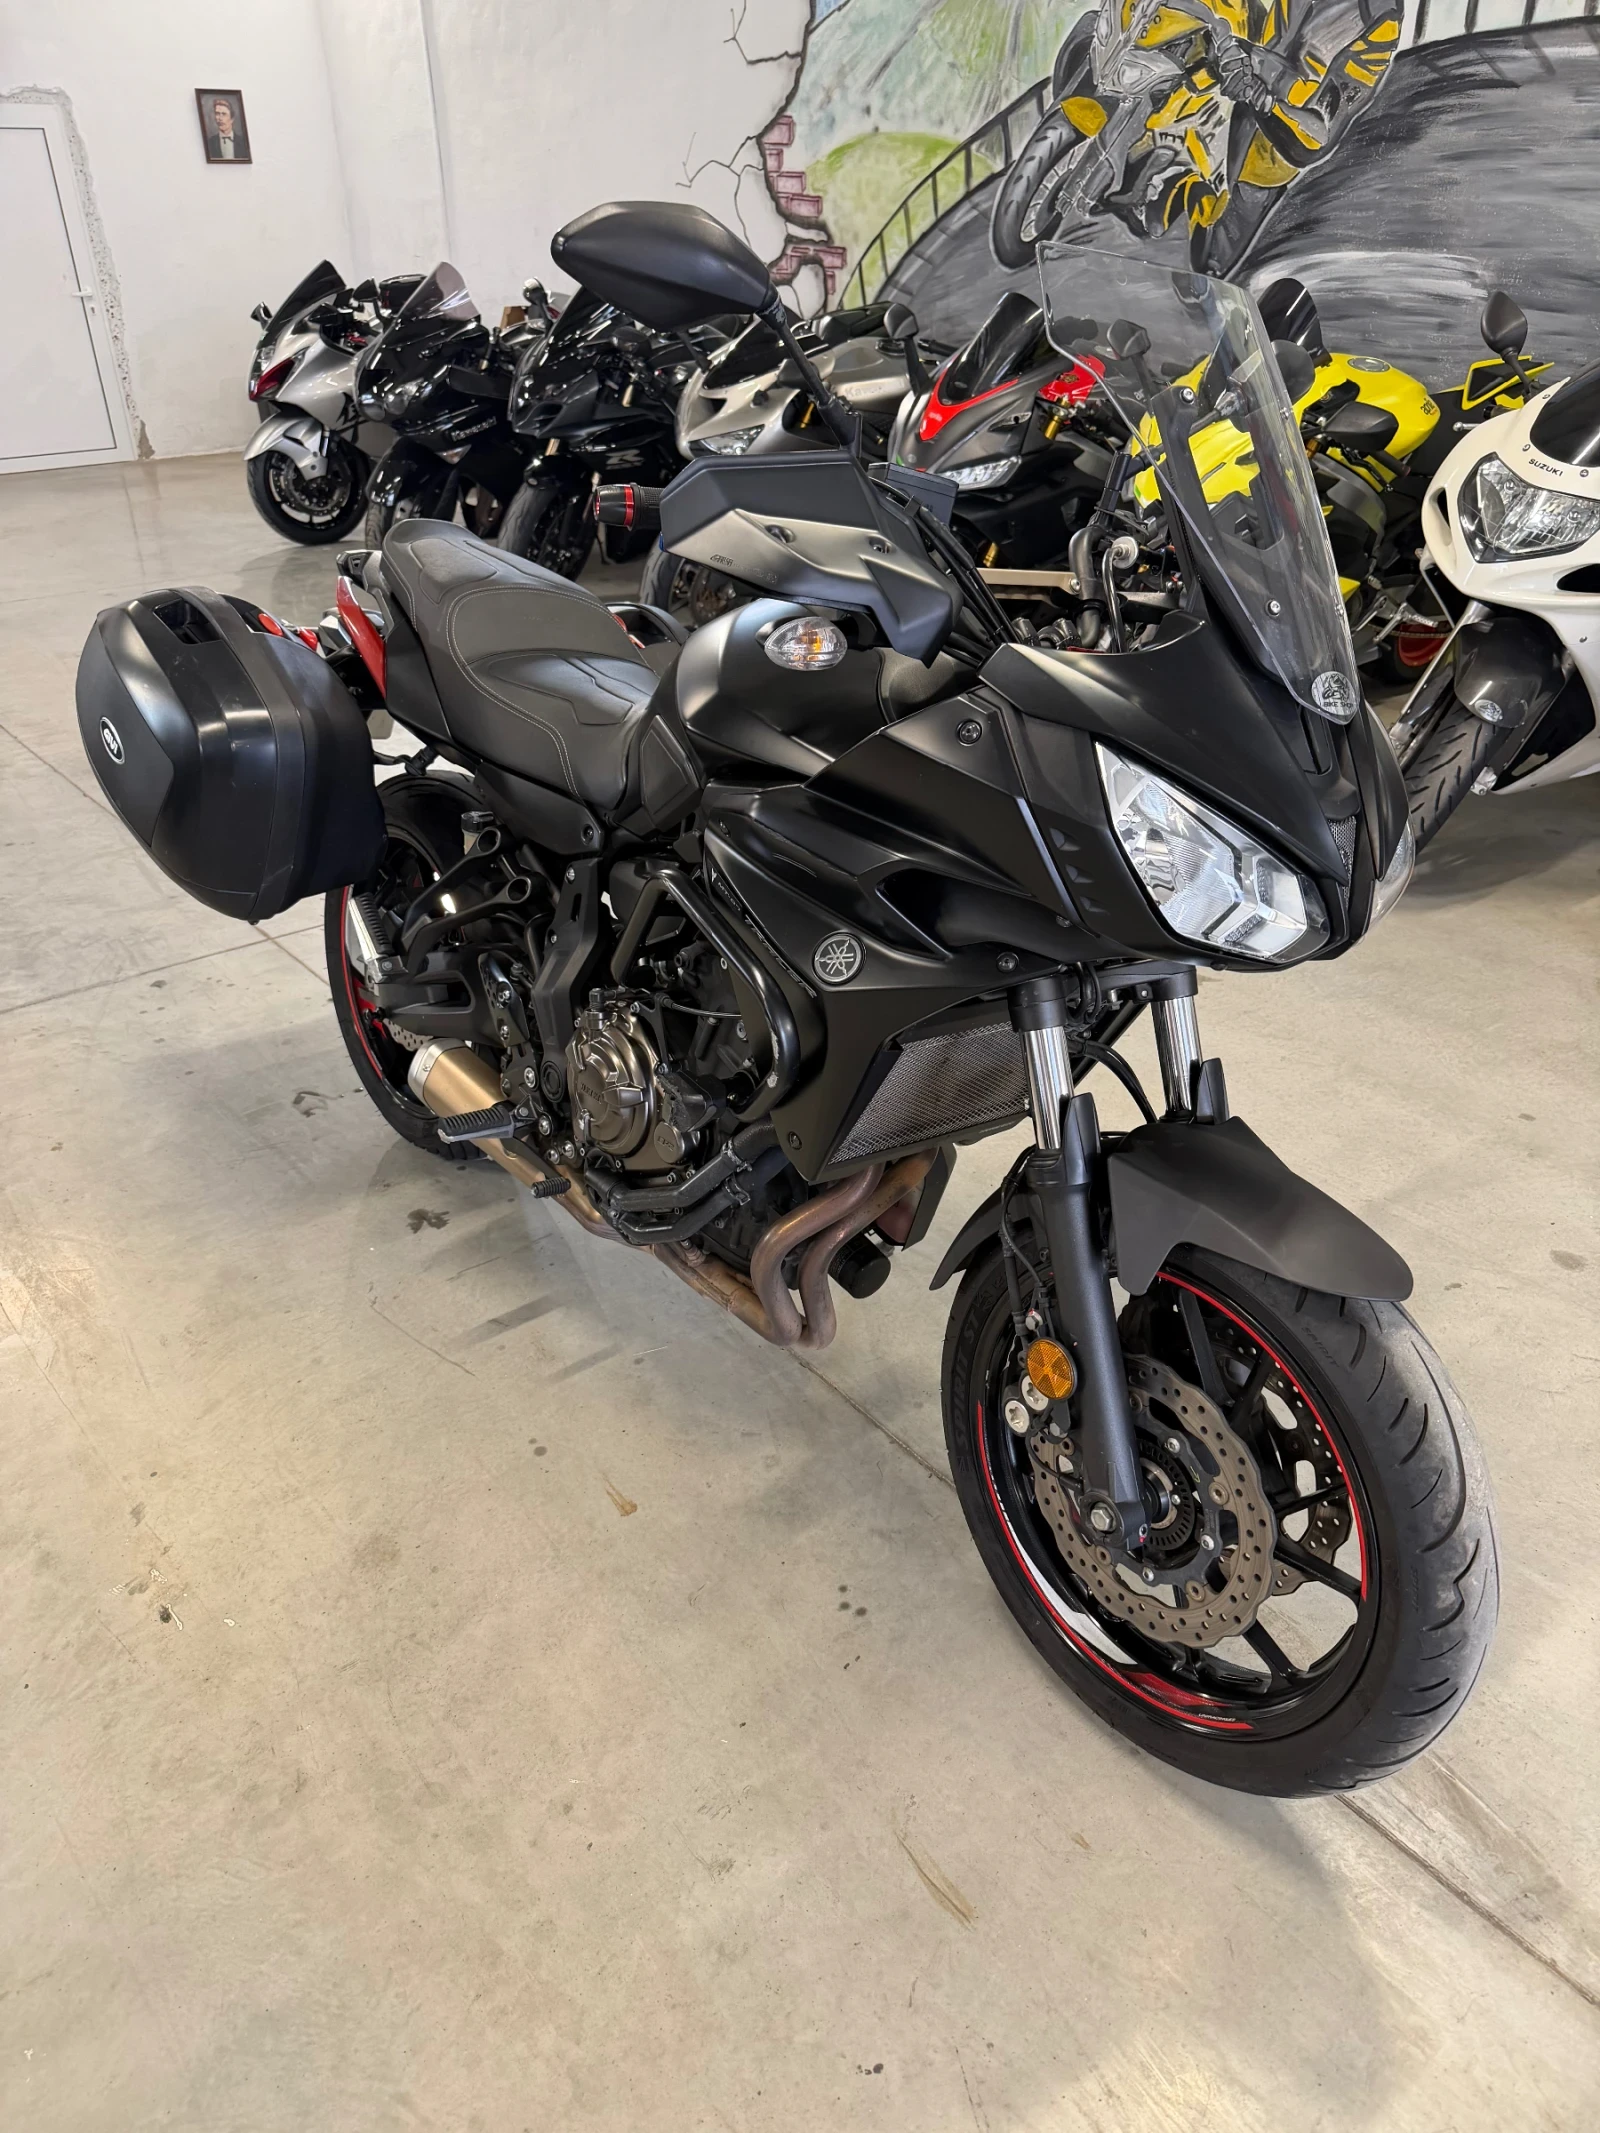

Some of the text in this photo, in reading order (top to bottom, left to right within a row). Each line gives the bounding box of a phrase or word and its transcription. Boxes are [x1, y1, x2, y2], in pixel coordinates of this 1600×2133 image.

[1528, 458, 1563, 477] SUZUKI
[952, 1350, 969, 1451] SPIRIT
[963, 1312, 981, 1345] ST
